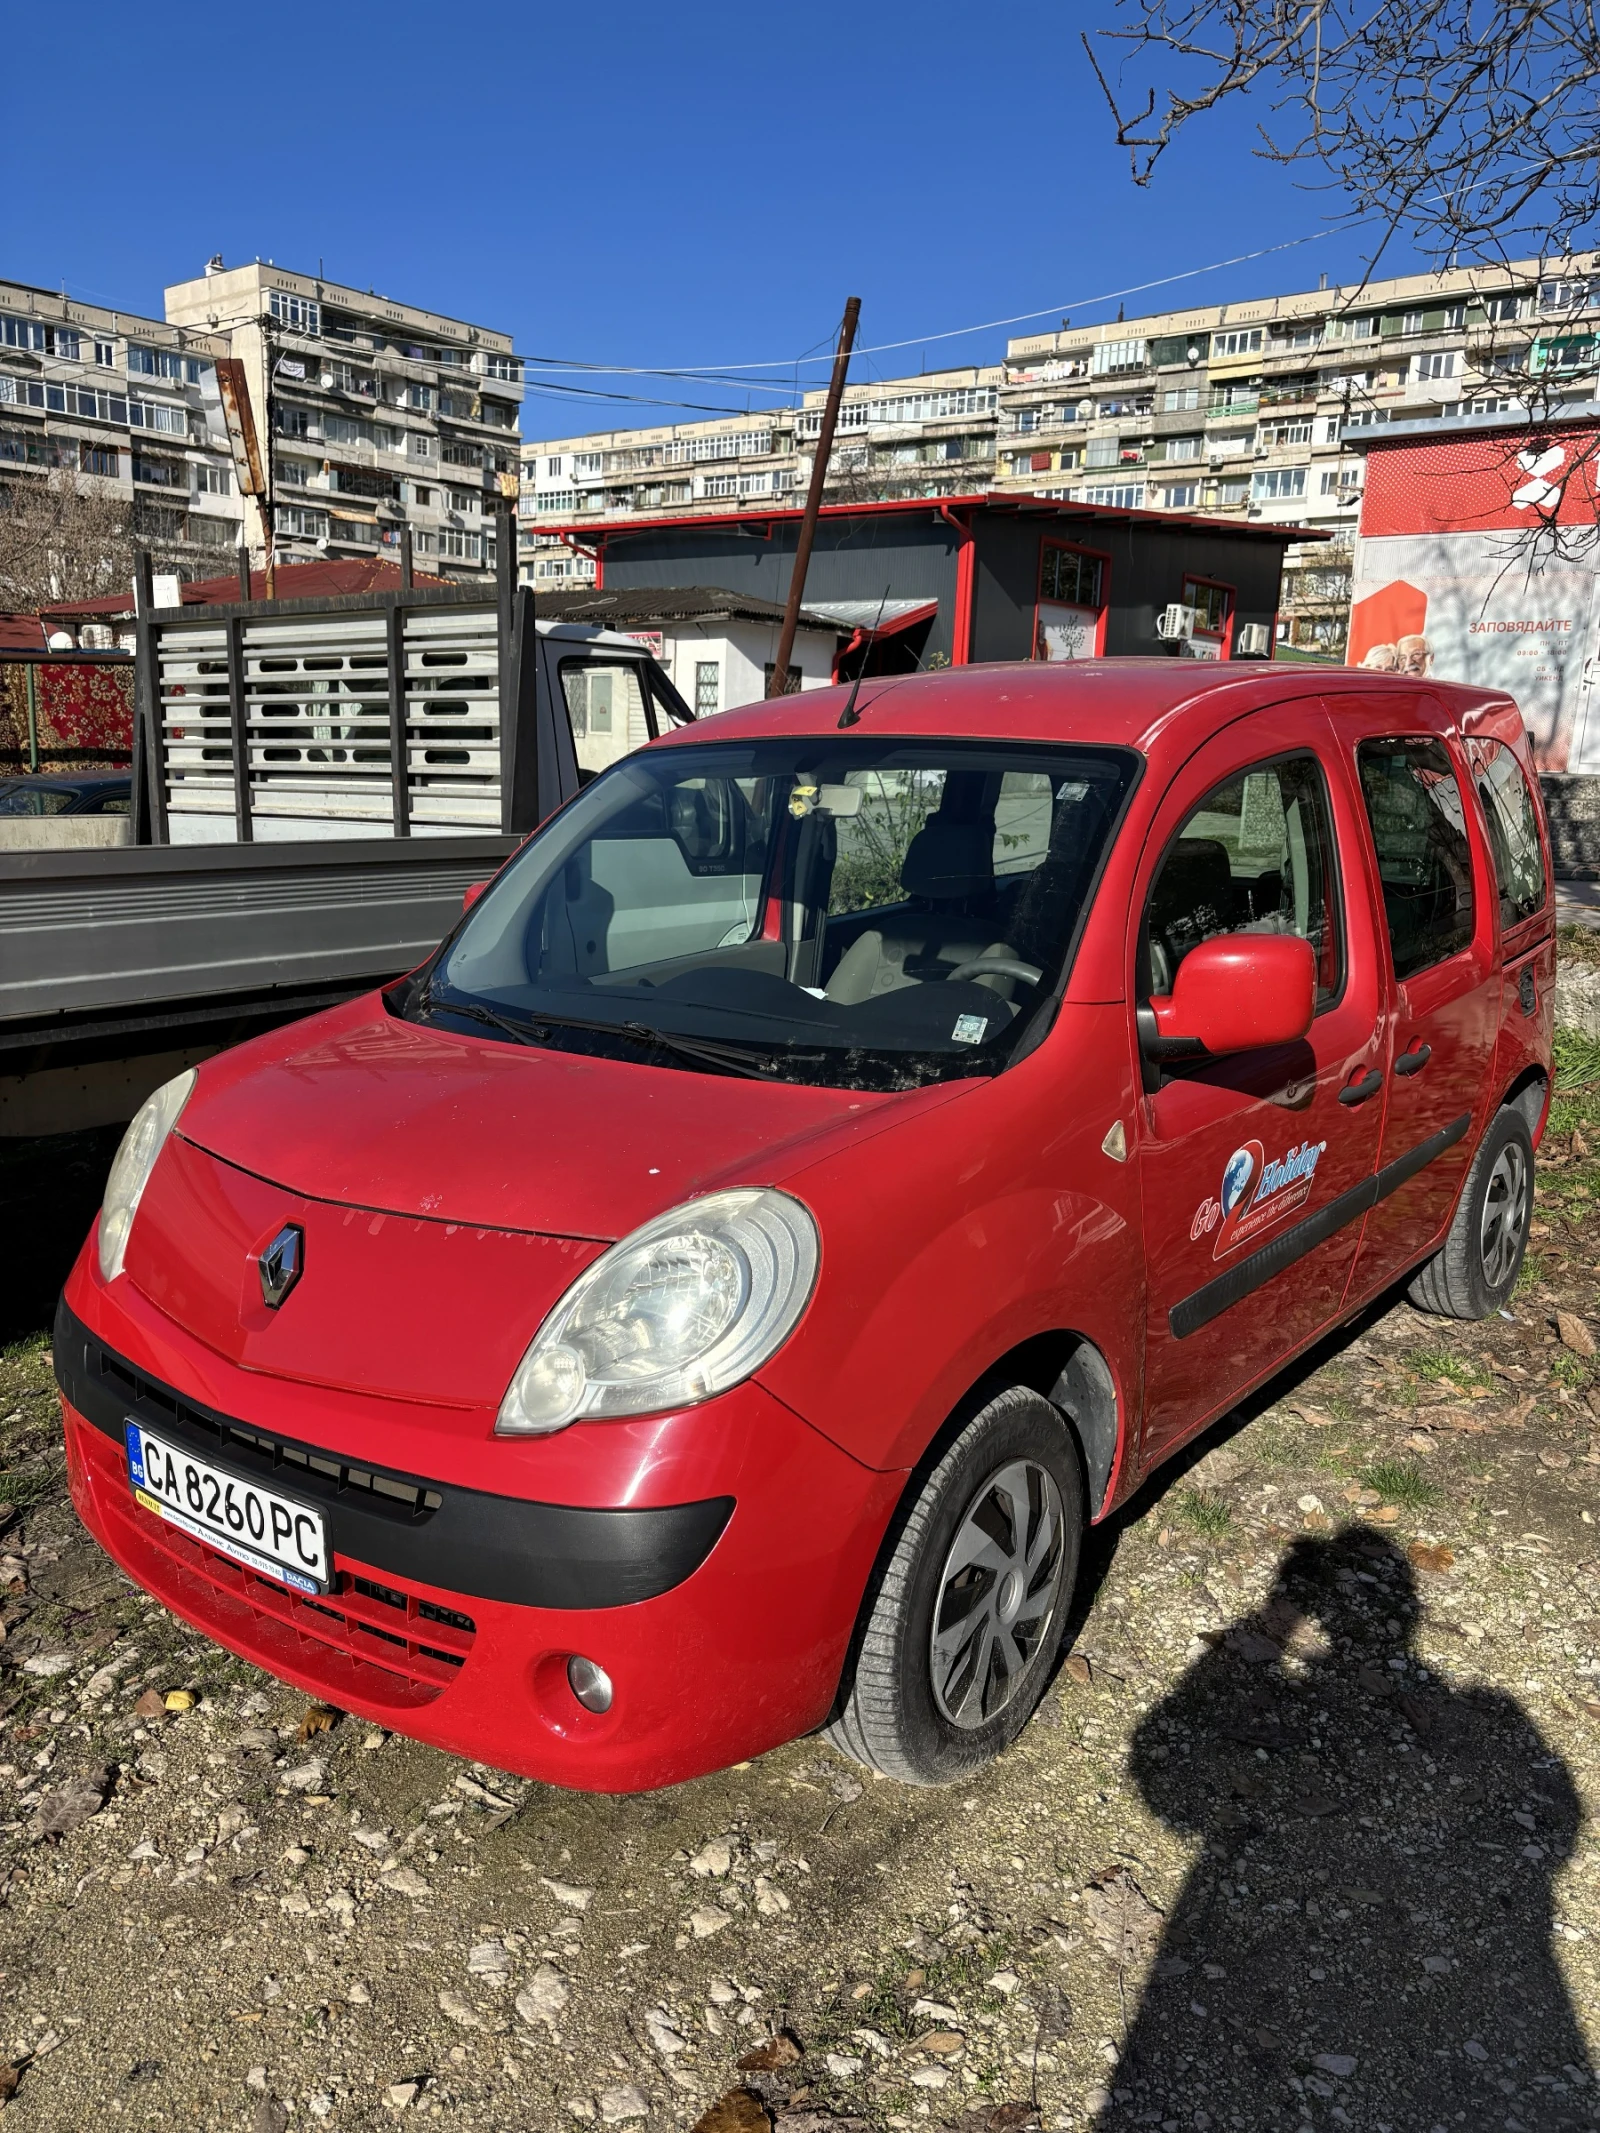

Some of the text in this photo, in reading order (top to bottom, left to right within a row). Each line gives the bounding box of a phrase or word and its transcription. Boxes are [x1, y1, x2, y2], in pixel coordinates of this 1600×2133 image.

[1469, 618, 1572, 633] ЗАПОВЯДАЙТЕ
[1254, 1141, 1323, 1203] Holiday
[131, 1460, 144, 1479] BG
[286, 1571, 314, 1590] DACIA
